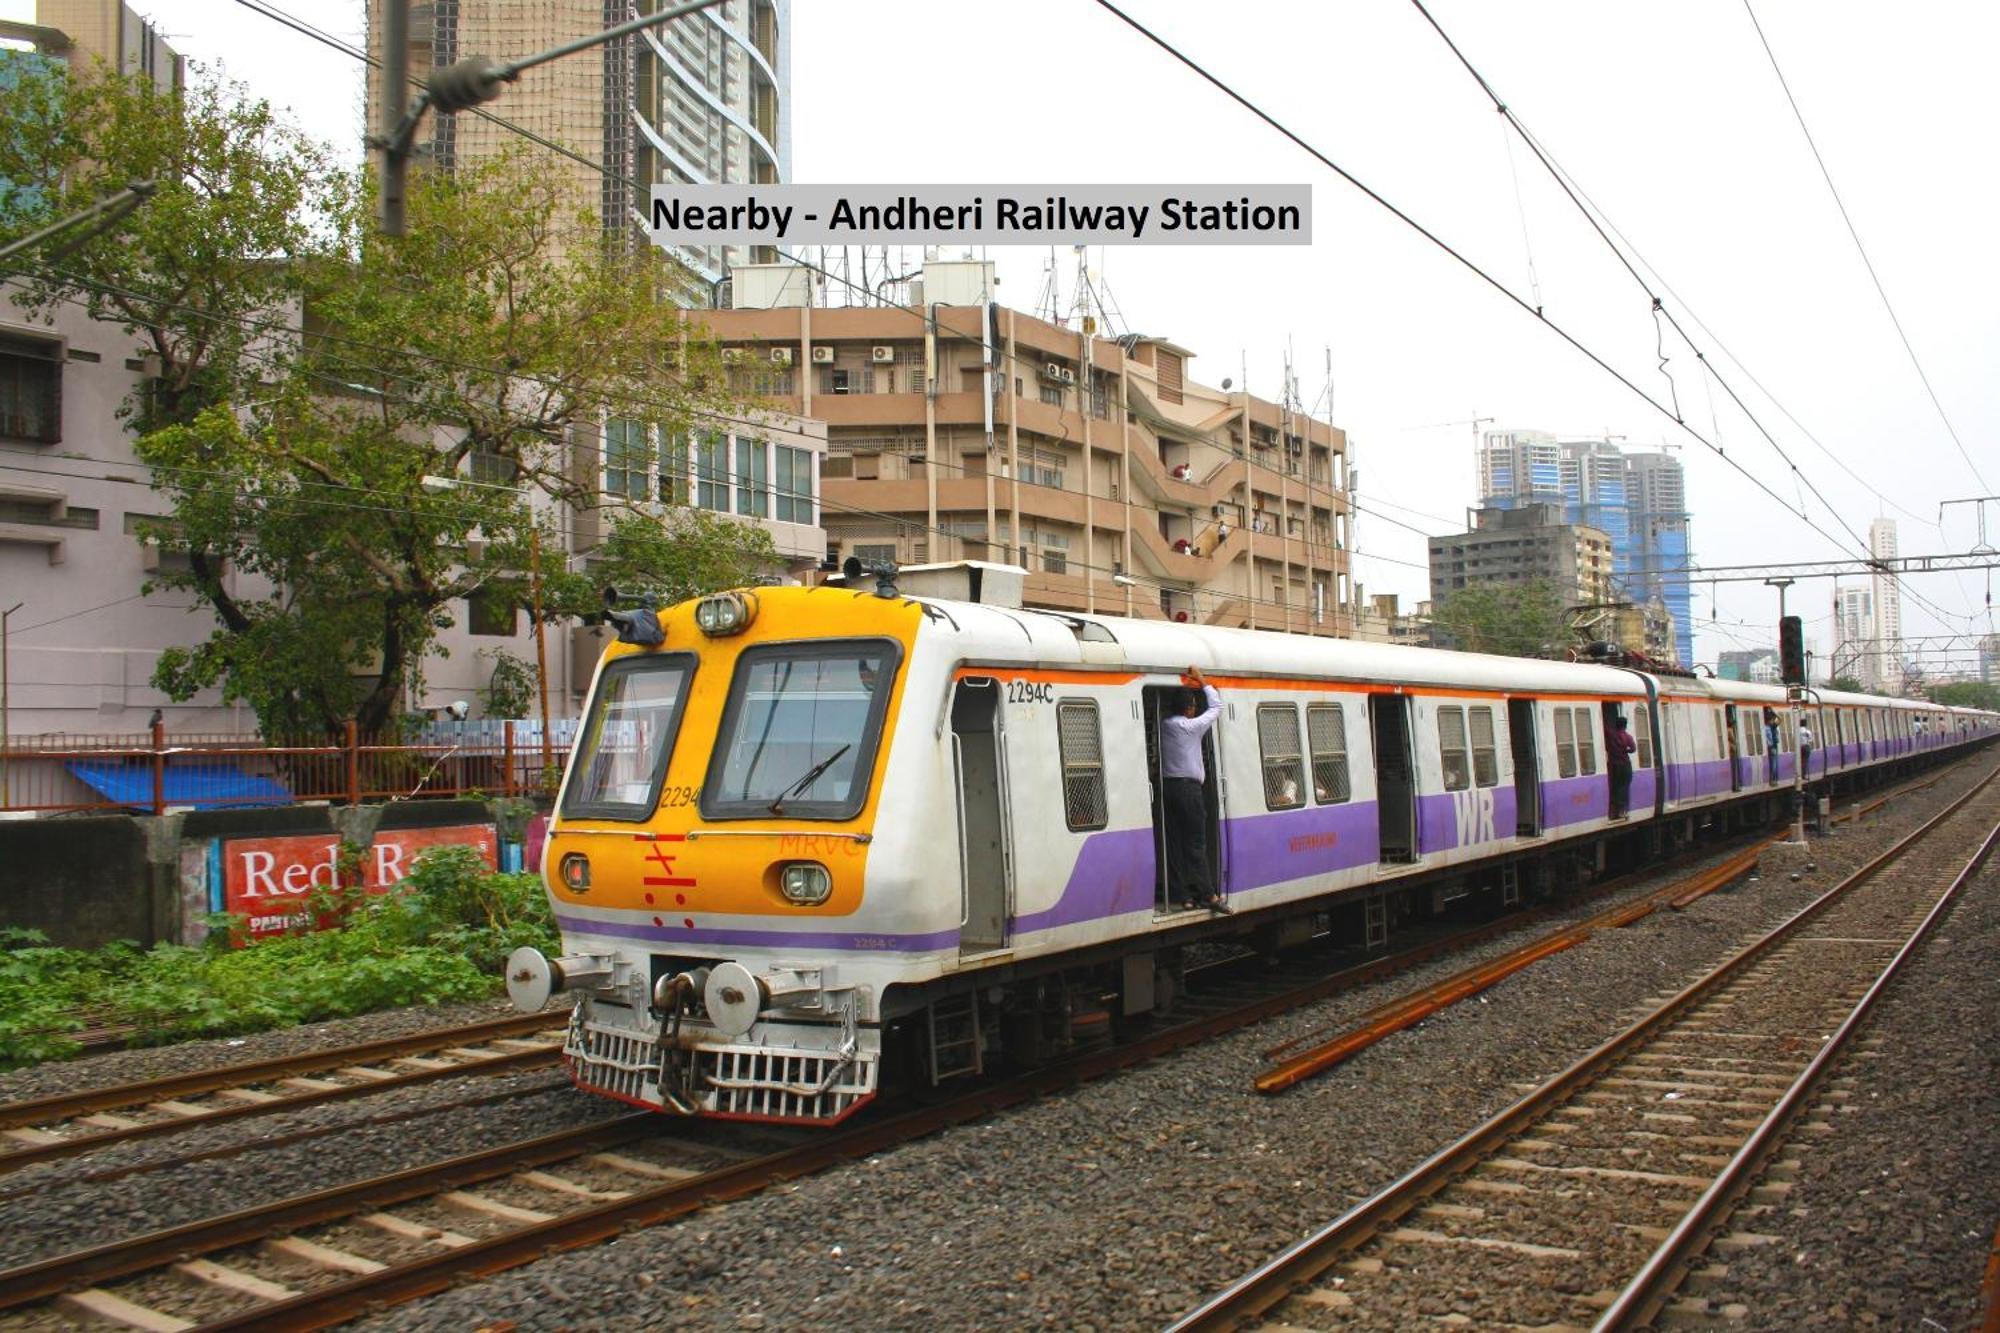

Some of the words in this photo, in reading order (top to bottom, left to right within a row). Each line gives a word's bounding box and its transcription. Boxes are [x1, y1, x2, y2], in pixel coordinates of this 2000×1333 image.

[1007, 681, 1054, 704] 2294C
[660, 786, 703, 808] 2294
[1453, 787, 1495, 846] WR
[239, 844, 341, 898] Red
